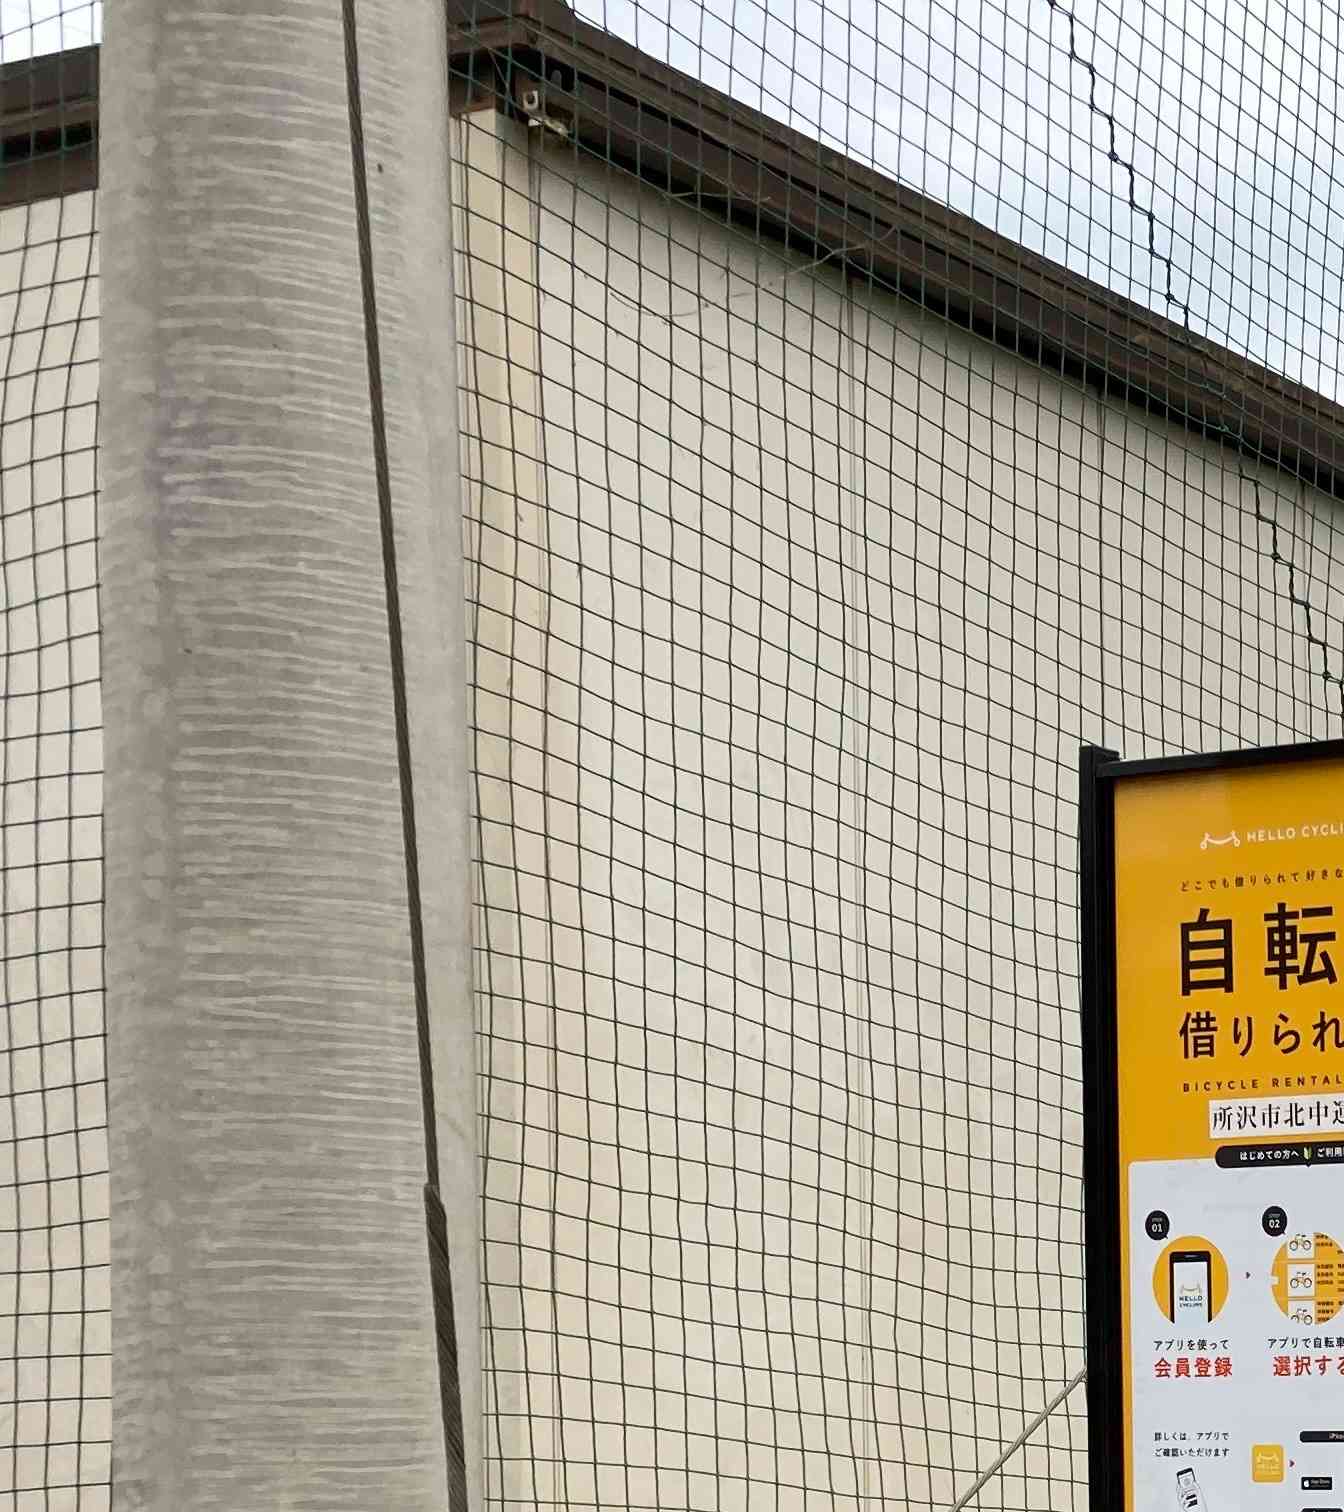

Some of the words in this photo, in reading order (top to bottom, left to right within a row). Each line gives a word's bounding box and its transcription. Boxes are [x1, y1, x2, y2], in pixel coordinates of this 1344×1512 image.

[1247, 827, 1296, 843] HELLO
[1183, 1079, 1259, 1093] BICYCLE
[1271, 1074, 1343, 1089] RENTAL
[1239, 1149, 1299, 1161] はじめての方へ
[1151, 1223, 1163, 1233] 01
[1268, 1219, 1280, 1229] 02
[1153, 1339, 1229, 1351] アプリを使って
[1154, 1356, 1233, 1378] 会員登録
[1154, 1447, 1230, 1458] ご確認いただけます
